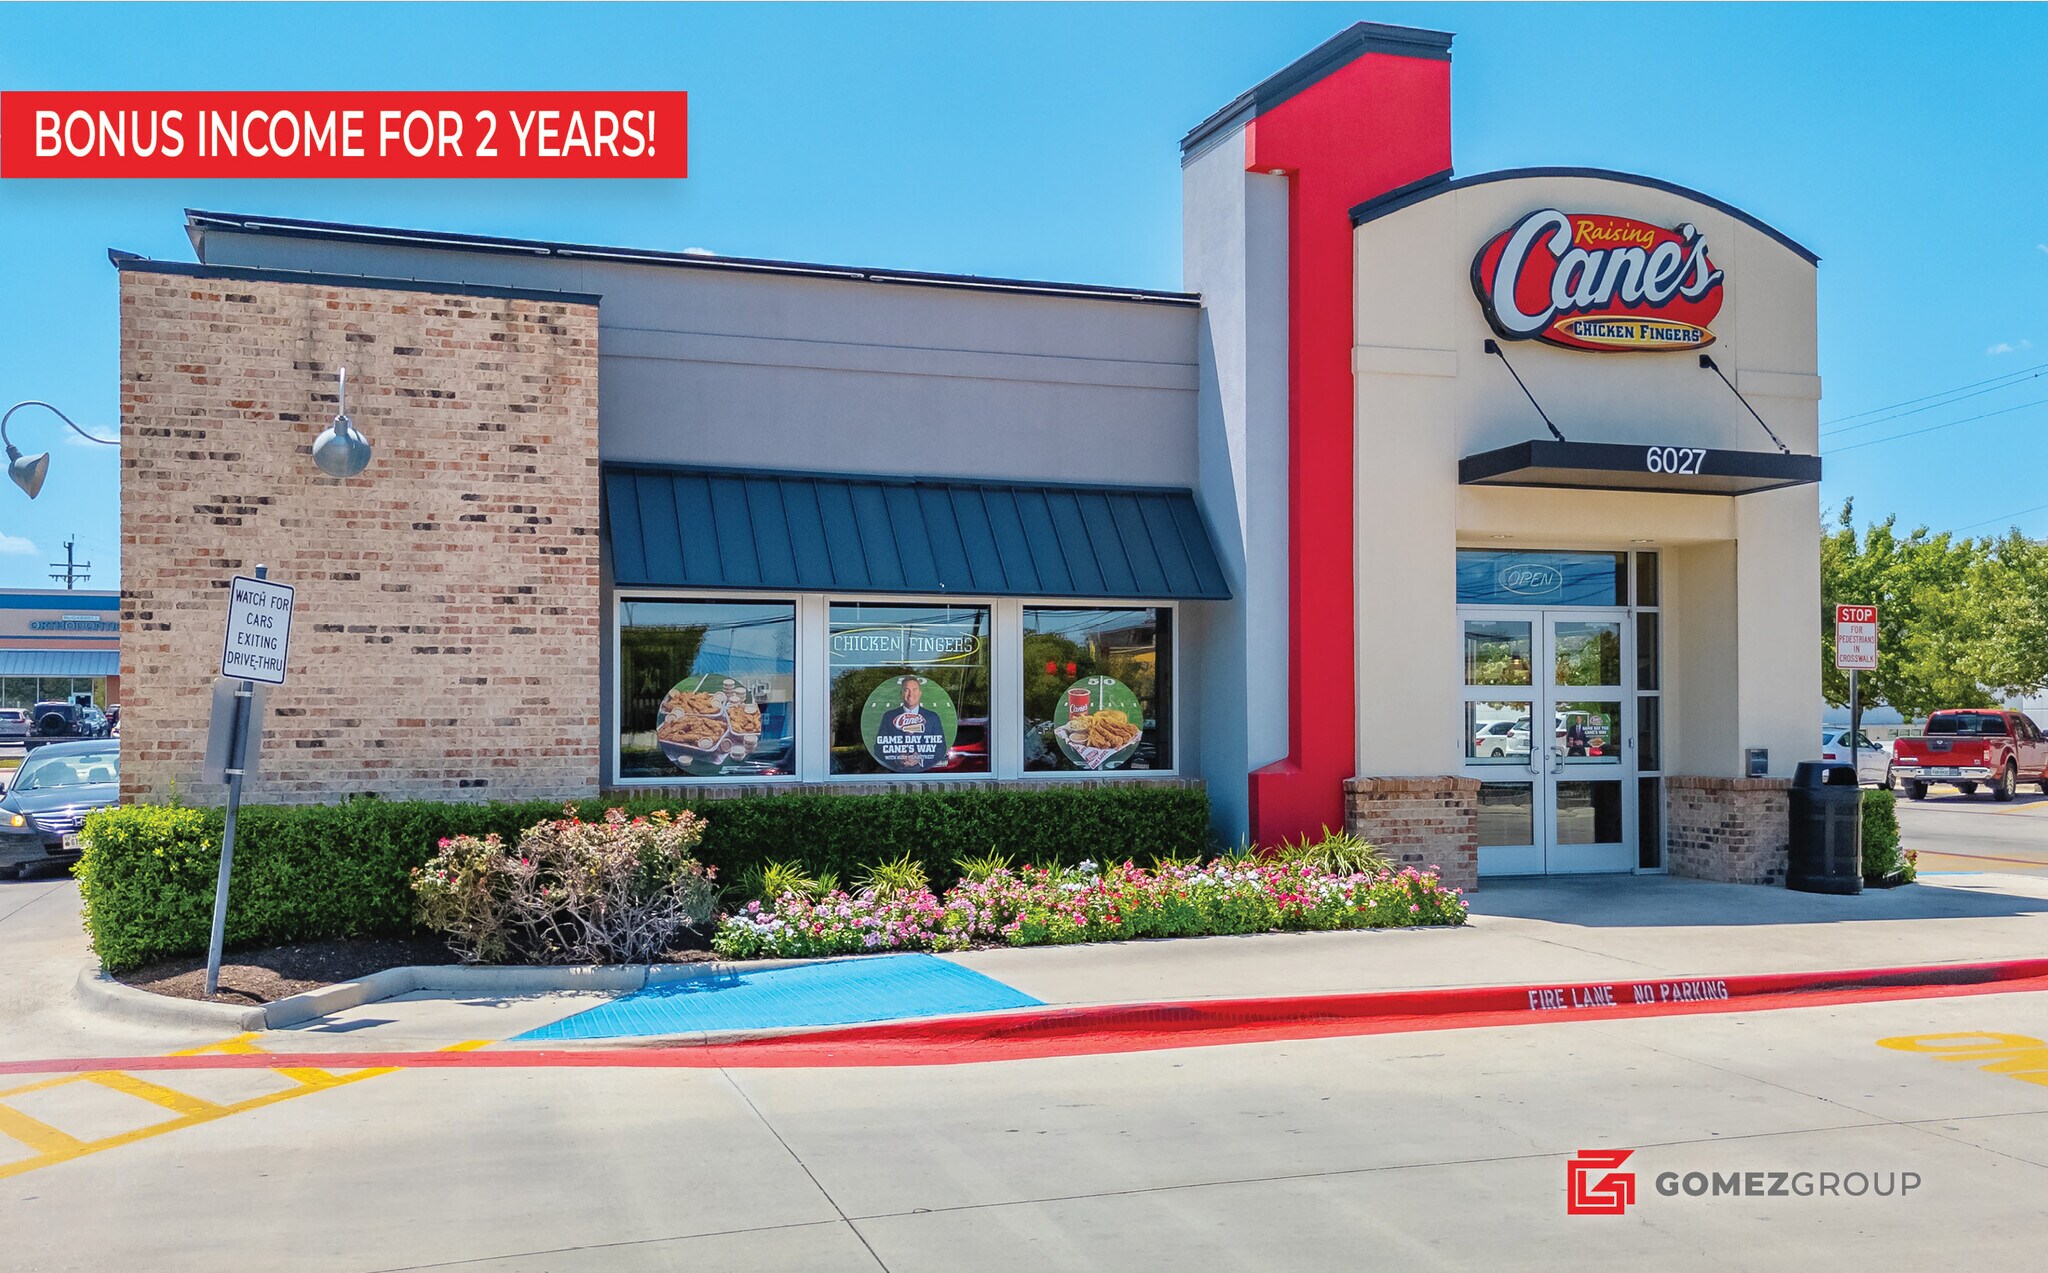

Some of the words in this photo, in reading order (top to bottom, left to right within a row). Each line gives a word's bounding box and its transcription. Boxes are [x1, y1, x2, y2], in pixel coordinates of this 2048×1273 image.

[1574, 219, 1655, 249] Raising
[1493, 209, 1723, 333] Cane's
[1573, 321, 1635, 340] CHICKEN
[1640, 325, 1701, 343] FINGERS
[1646, 447, 1707, 475] 6027
[1507, 570, 1554, 587] OPEN
[235, 588, 267, 607] WATCH
[270, 596, 290, 612] FOR
[246, 612, 274, 629] CARS
[1842, 608, 1872, 622] STOP
[1850, 625, 1864, 634] FOR
[237, 631, 278, 651] EXITING
[834, 635, 901, 652] CHICKEN
[909, 637, 973, 653] FINGERS
[1839, 635, 1875, 645] PEDESTRIANS
[1853, 645, 1860, 653] IN
[227, 650, 283, 672] DRIVE-THRU
[1839, 654, 1874, 663] CROSSWALK
[876, 735, 904, 745] GAME
[904, 735, 922, 744] DAY
[923, 735, 943, 744] THE
[882, 744, 915, 754] CANE'S
[916, 744, 937, 753] WAY
[1528, 989, 1567, 1010] FIRE
[1571, 985, 1617, 1008] LANE
[1633, 984, 1655, 1004] NO
[1659, 980, 1729, 1003] PARKING
